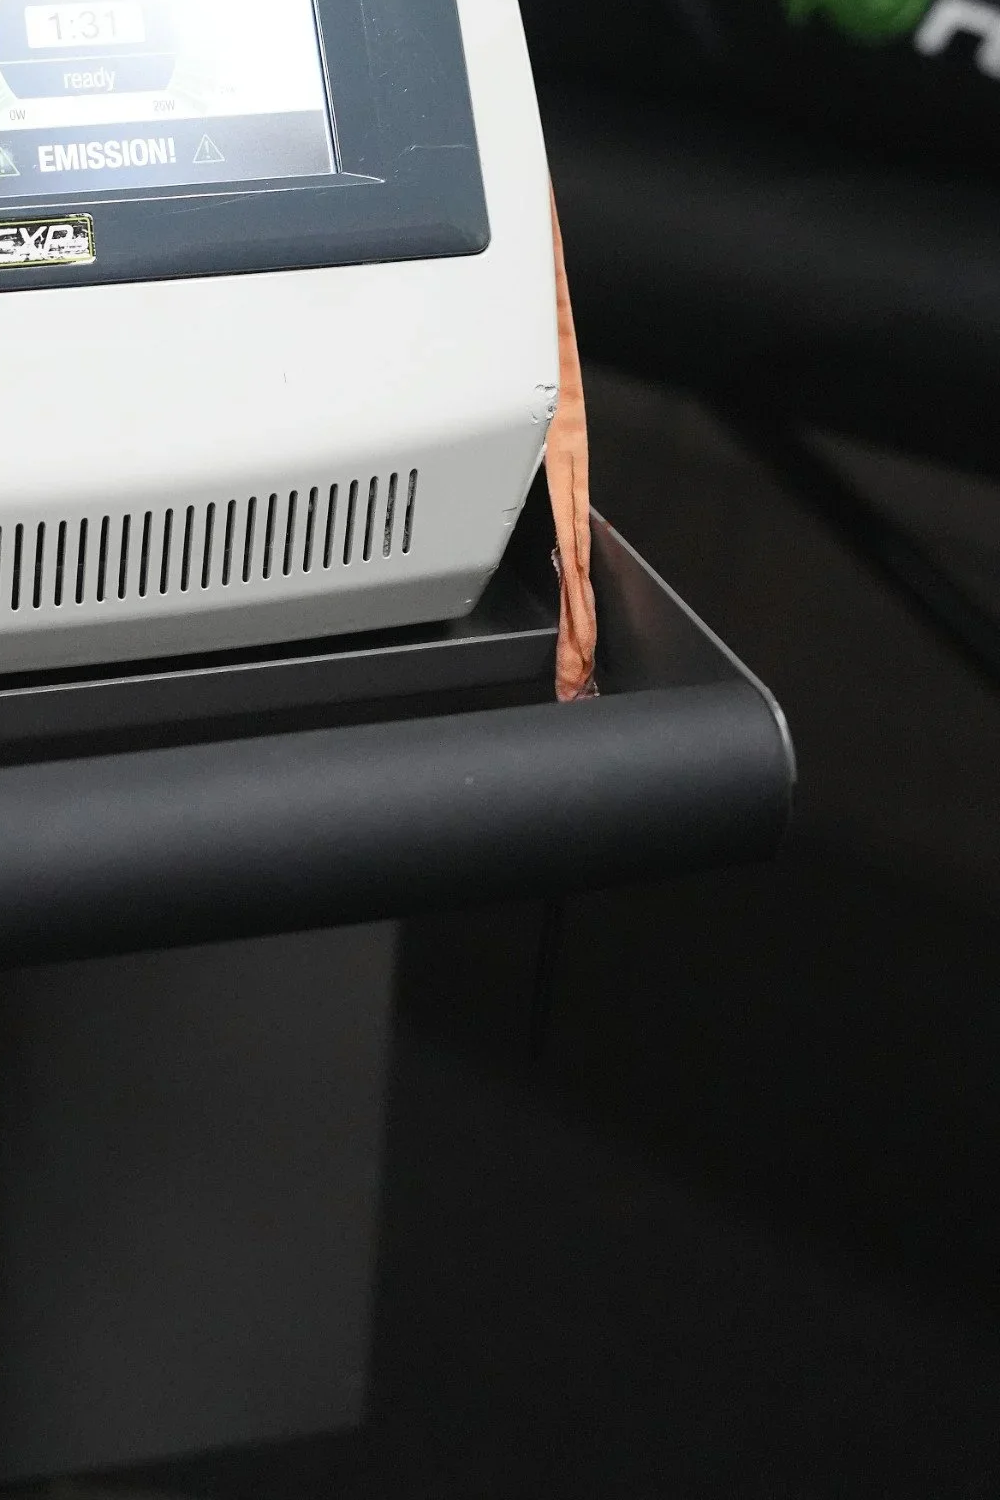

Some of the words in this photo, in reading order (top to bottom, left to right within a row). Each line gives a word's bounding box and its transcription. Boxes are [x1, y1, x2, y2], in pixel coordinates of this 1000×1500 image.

[47, 8, 119, 41] 1:31
[63, 67, 116, 94] ready
[37, 136, 176, 173] EMISSION!
